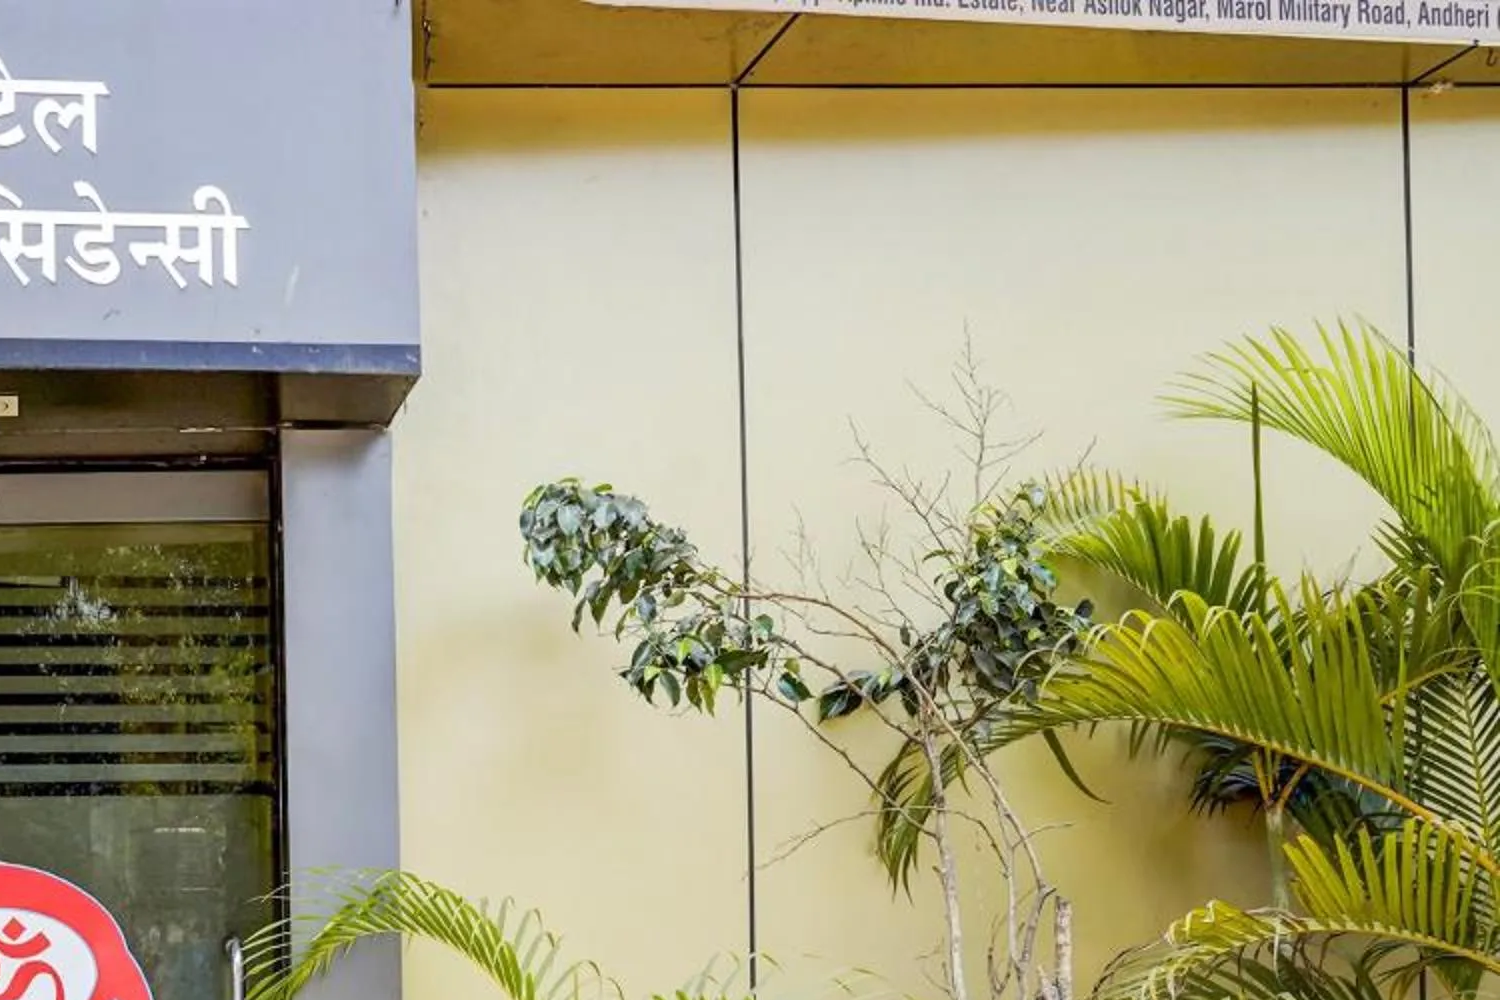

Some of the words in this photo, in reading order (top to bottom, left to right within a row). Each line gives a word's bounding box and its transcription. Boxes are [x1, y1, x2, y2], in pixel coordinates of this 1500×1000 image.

[1217, 0, 1271, 20] Marol
[1279, 0, 1350, 28] Military
[1357, 0, 1411, 28] Road,
[1418, 2, 1489, 28] Andheri
